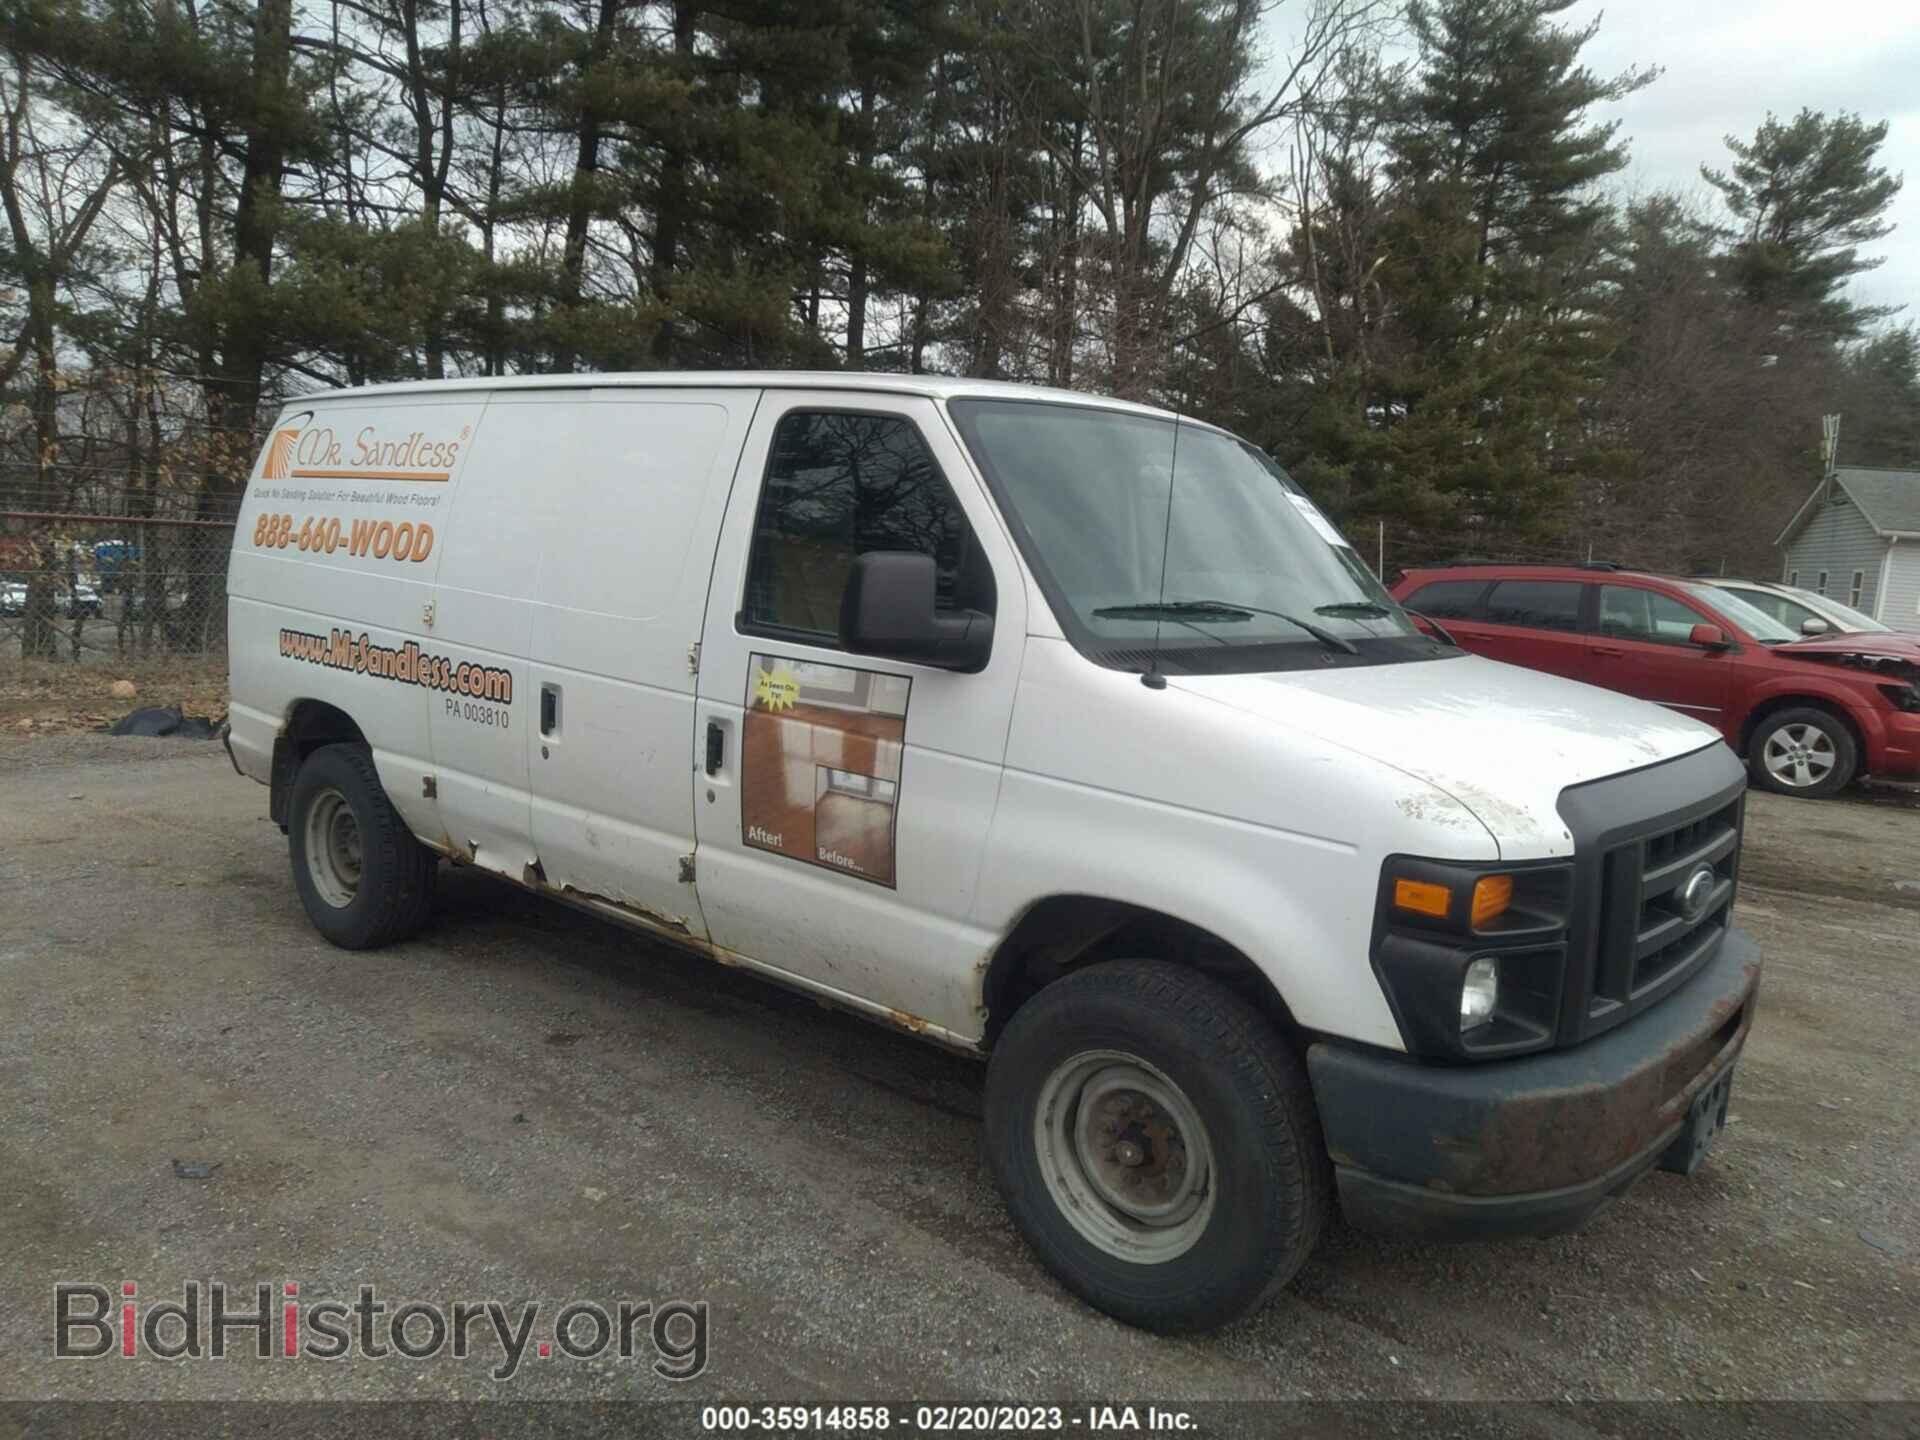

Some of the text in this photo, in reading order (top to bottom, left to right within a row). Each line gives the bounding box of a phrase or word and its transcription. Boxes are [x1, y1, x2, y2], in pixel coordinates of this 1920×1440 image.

[337, 489, 351, 501] For
[386, 491, 409, 505] Wood
[253, 513, 434, 562] 888-660-WOOD
[279, 628, 513, 704] www.MrSandless.com
[446, 698, 509, 729] PA 003810
[748, 826, 783, 847] After!
